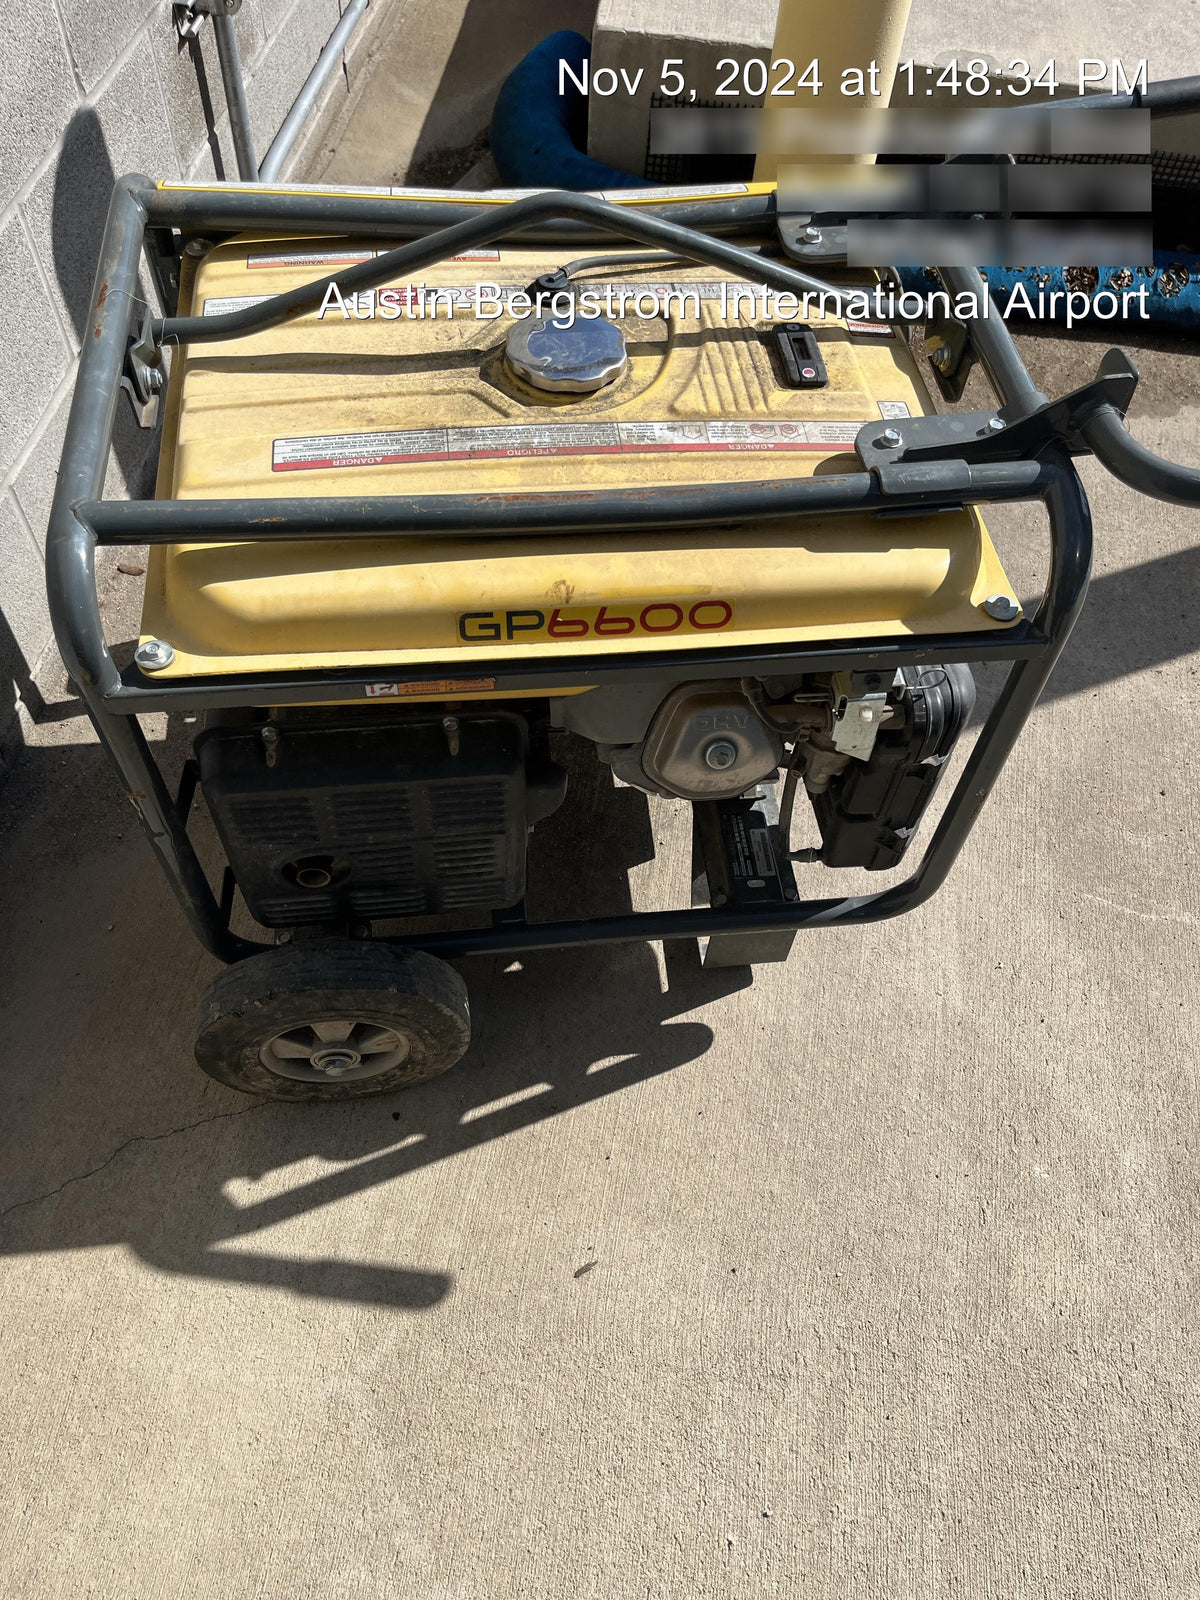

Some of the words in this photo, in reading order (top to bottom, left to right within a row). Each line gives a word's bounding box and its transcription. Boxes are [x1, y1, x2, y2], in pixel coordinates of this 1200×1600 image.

[506, 448, 549, 457] PELIGRO
[332, 456, 374, 466] DANGER
[459, 600, 733, 641] GP6600
